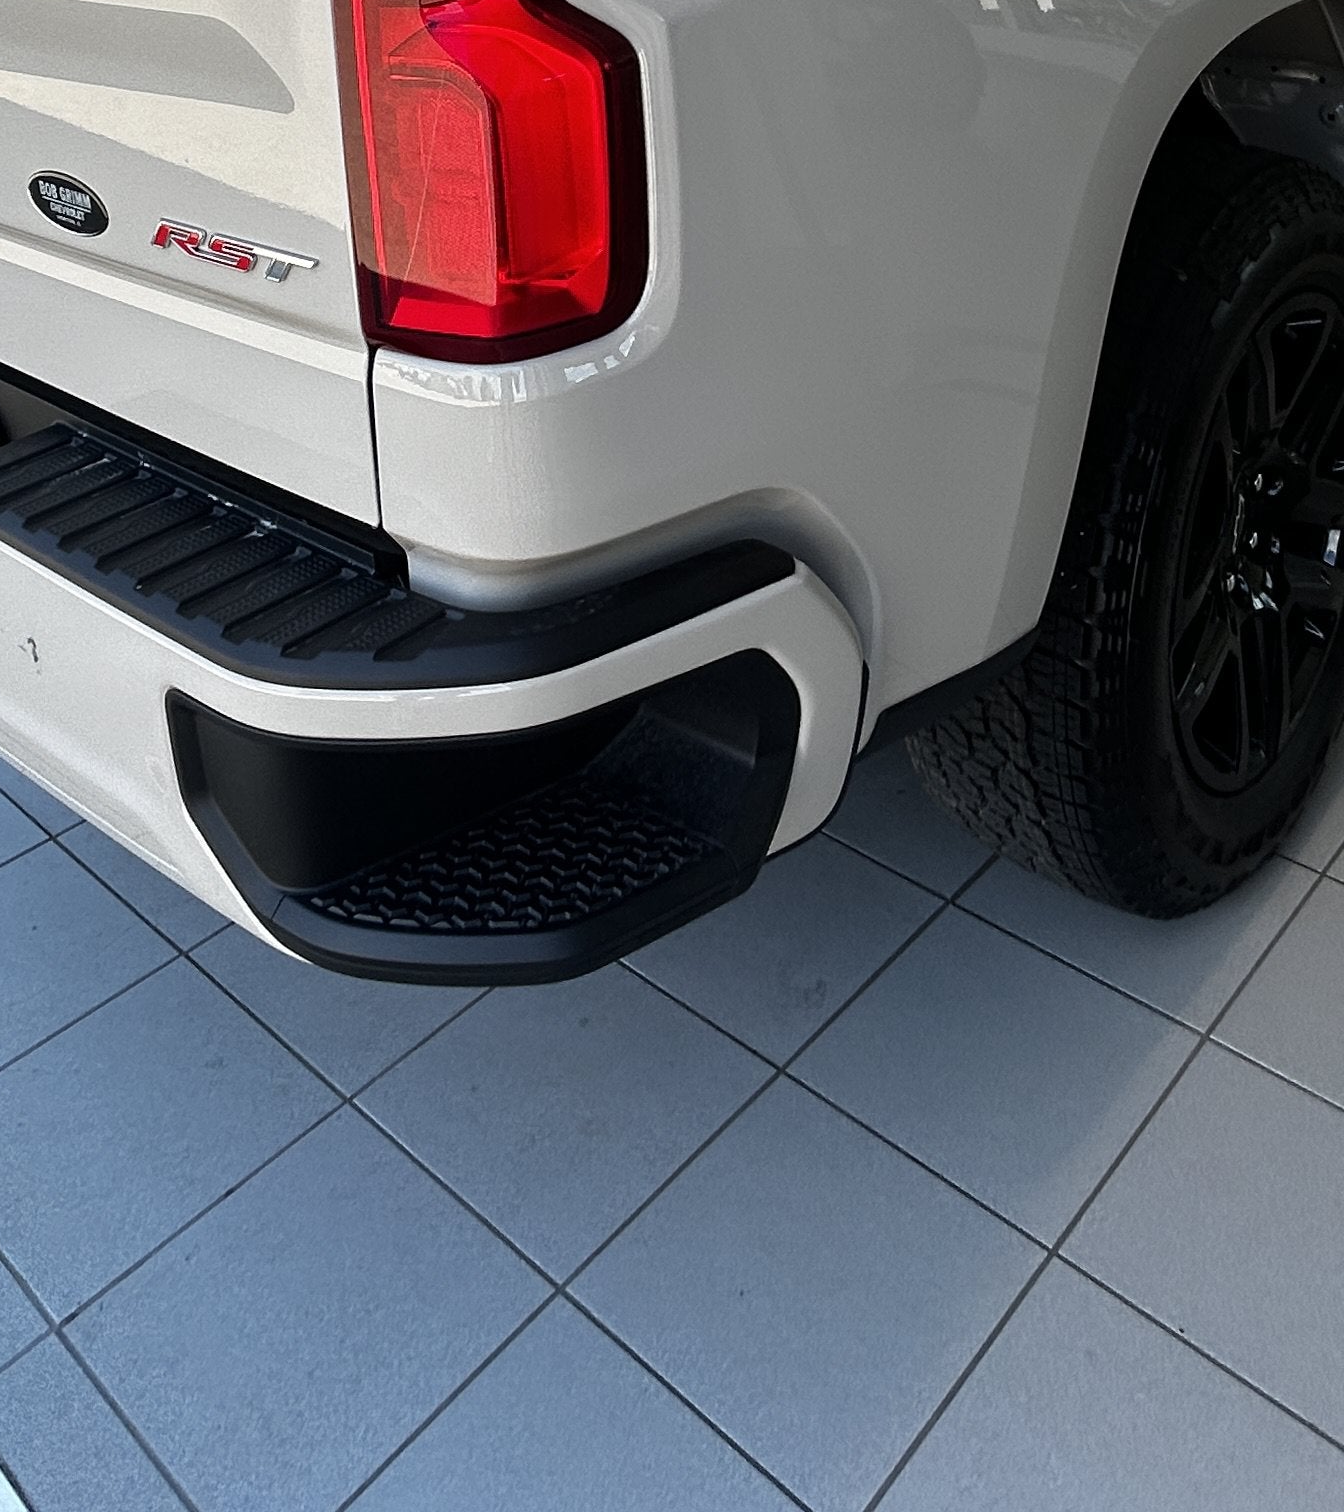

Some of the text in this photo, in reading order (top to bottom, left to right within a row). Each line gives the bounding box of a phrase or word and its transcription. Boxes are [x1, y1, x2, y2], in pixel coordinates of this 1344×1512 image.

[38, 179, 92, 210] BOB GRIMM
[152, 217, 320, 283] RST
